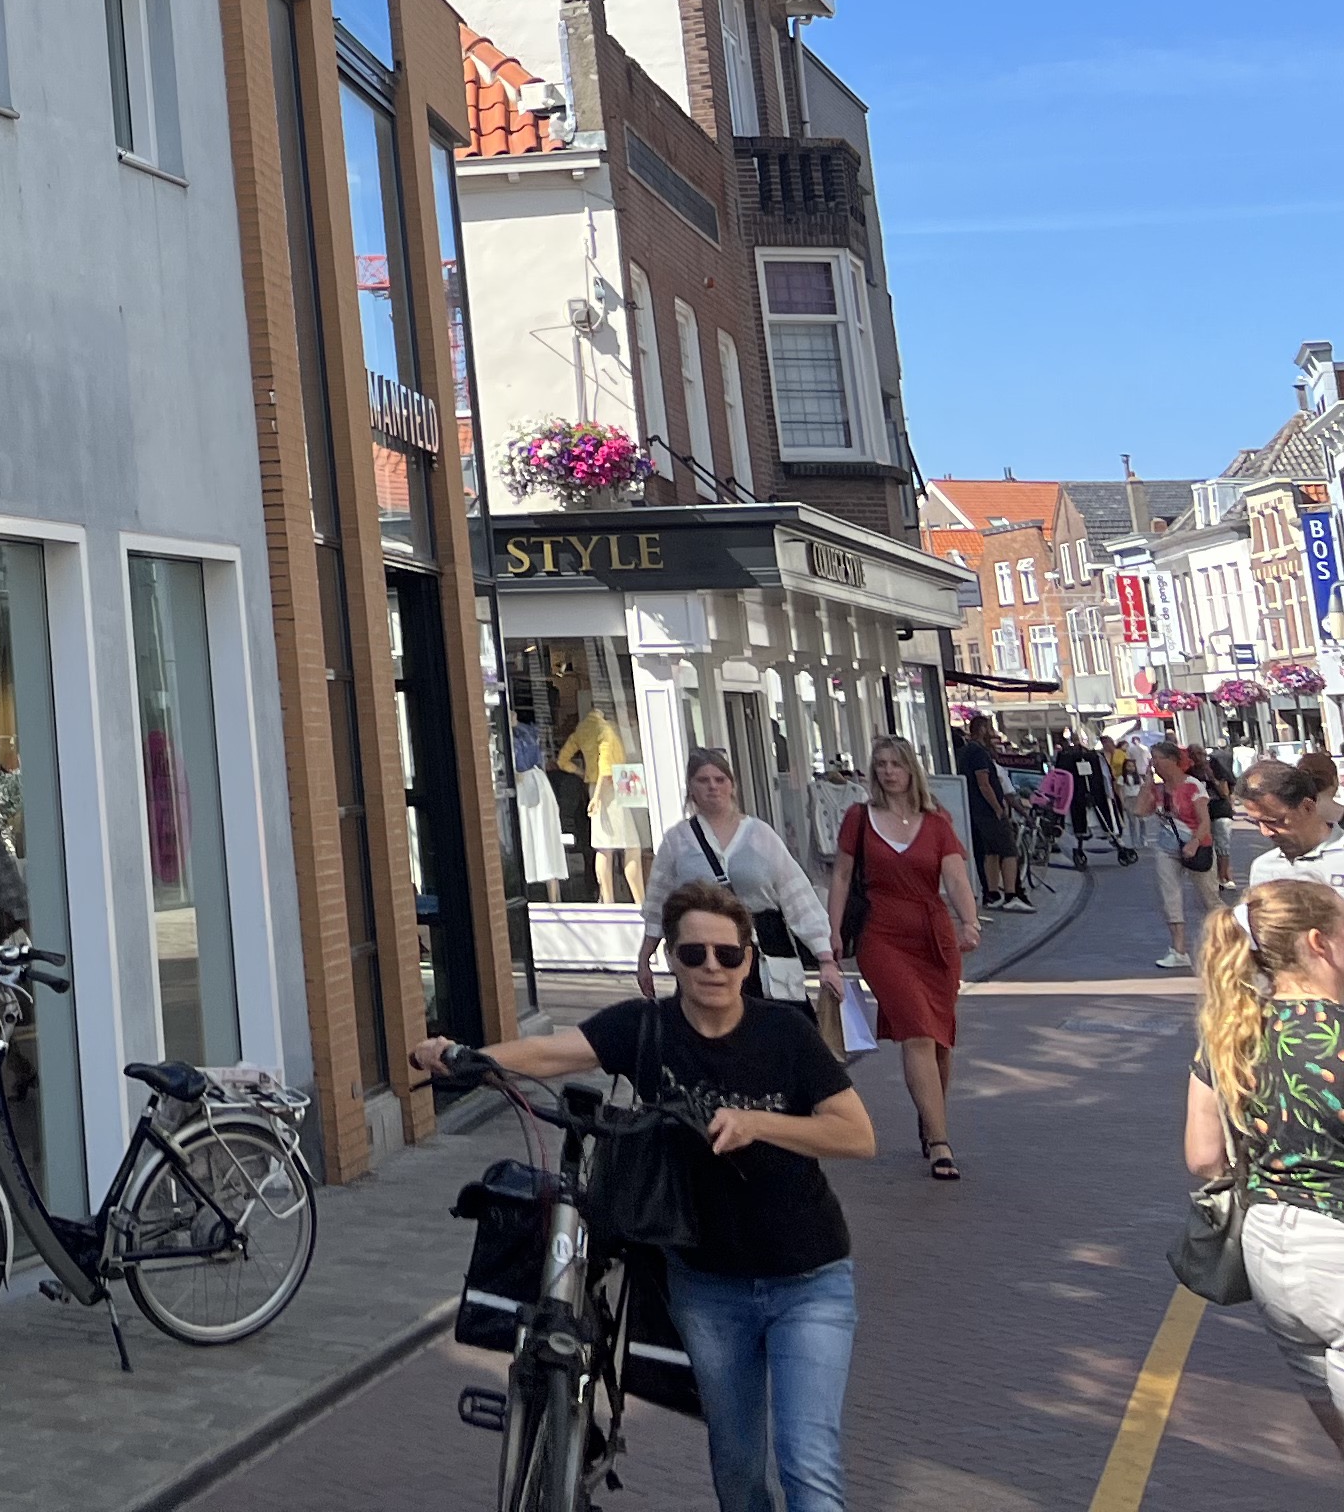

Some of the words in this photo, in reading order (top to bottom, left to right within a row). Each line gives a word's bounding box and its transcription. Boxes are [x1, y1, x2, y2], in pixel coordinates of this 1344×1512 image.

[366, 370, 440, 454] MANFIELD
[506, 533, 665, 574] STYLE
[1309, 519, 1331, 581] BOS
[1160, 606, 1171, 621] de
